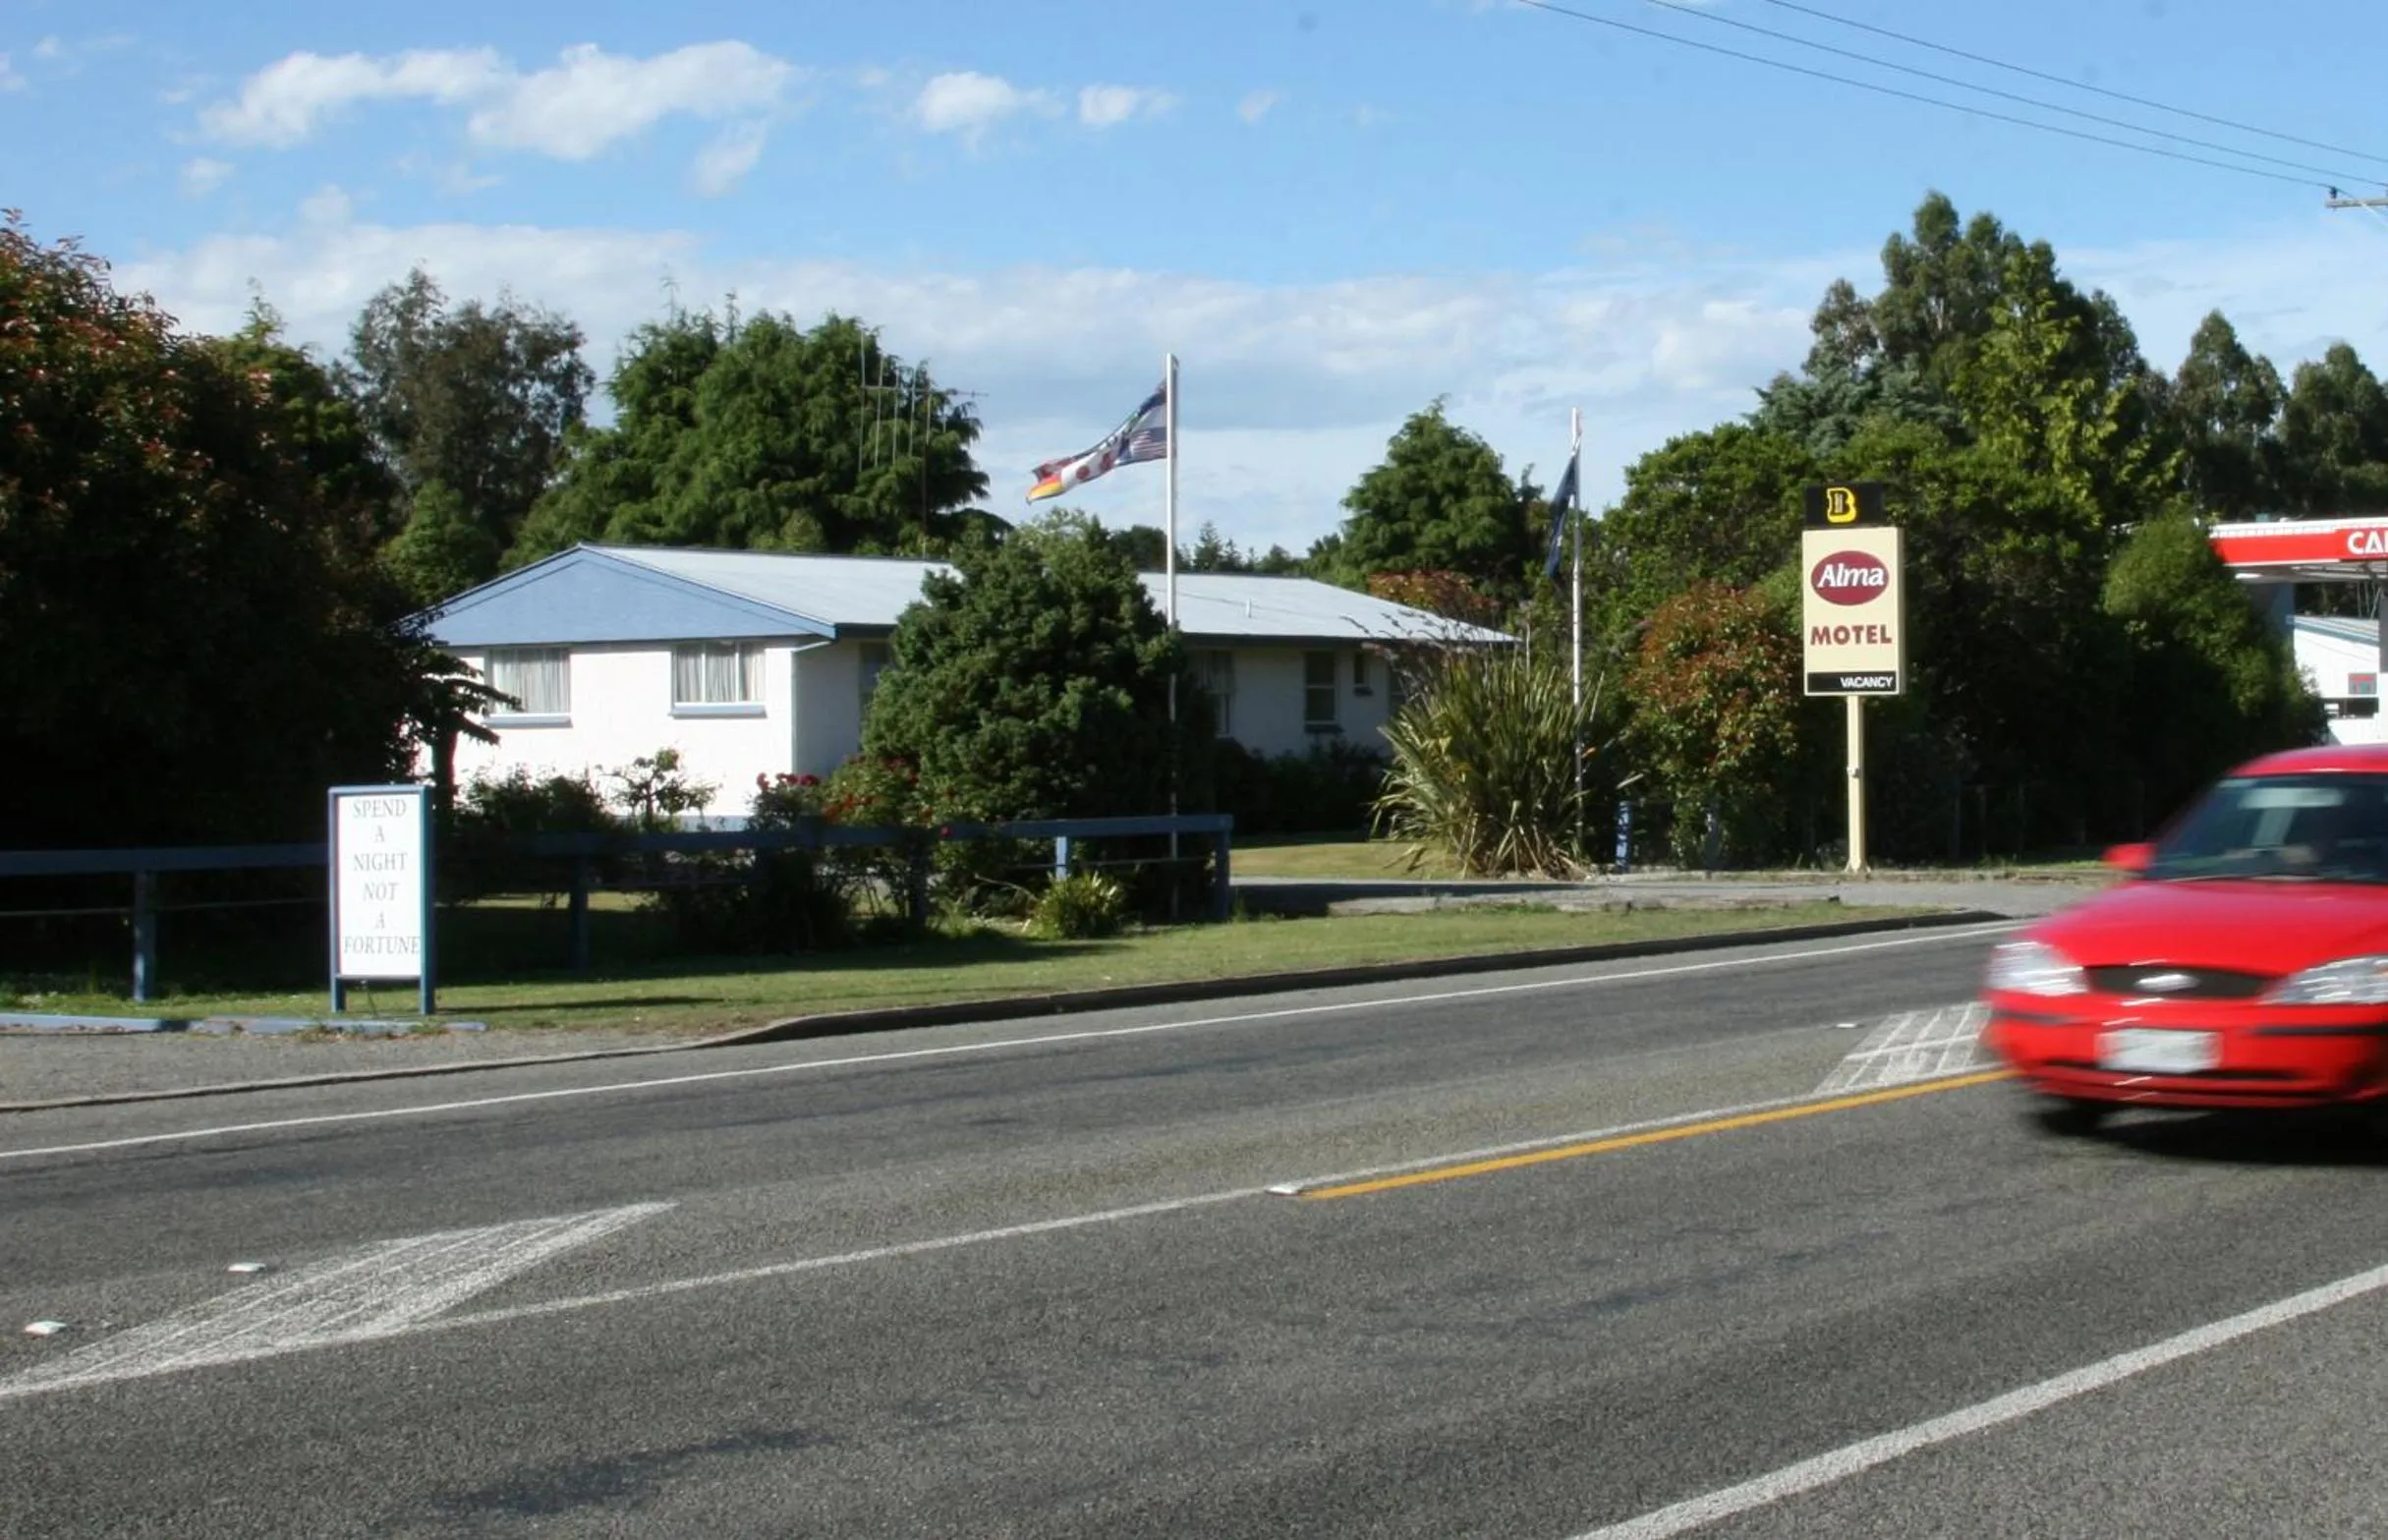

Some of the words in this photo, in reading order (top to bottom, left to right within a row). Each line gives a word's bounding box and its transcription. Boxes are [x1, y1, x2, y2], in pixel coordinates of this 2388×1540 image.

[1818, 563, 1884, 588] Alma
[1811, 624, 1892, 646] MOTEL
[1840, 676, 1893, 688] VACANCY
[353, 799, 407, 818] SPEND
[373, 825, 385, 842] A
[354, 852, 408, 872] NIGHT
[363, 883, 398, 900] NOT
[374, 912, 385, 929] A
[344, 936, 420, 954] FORTUNE
